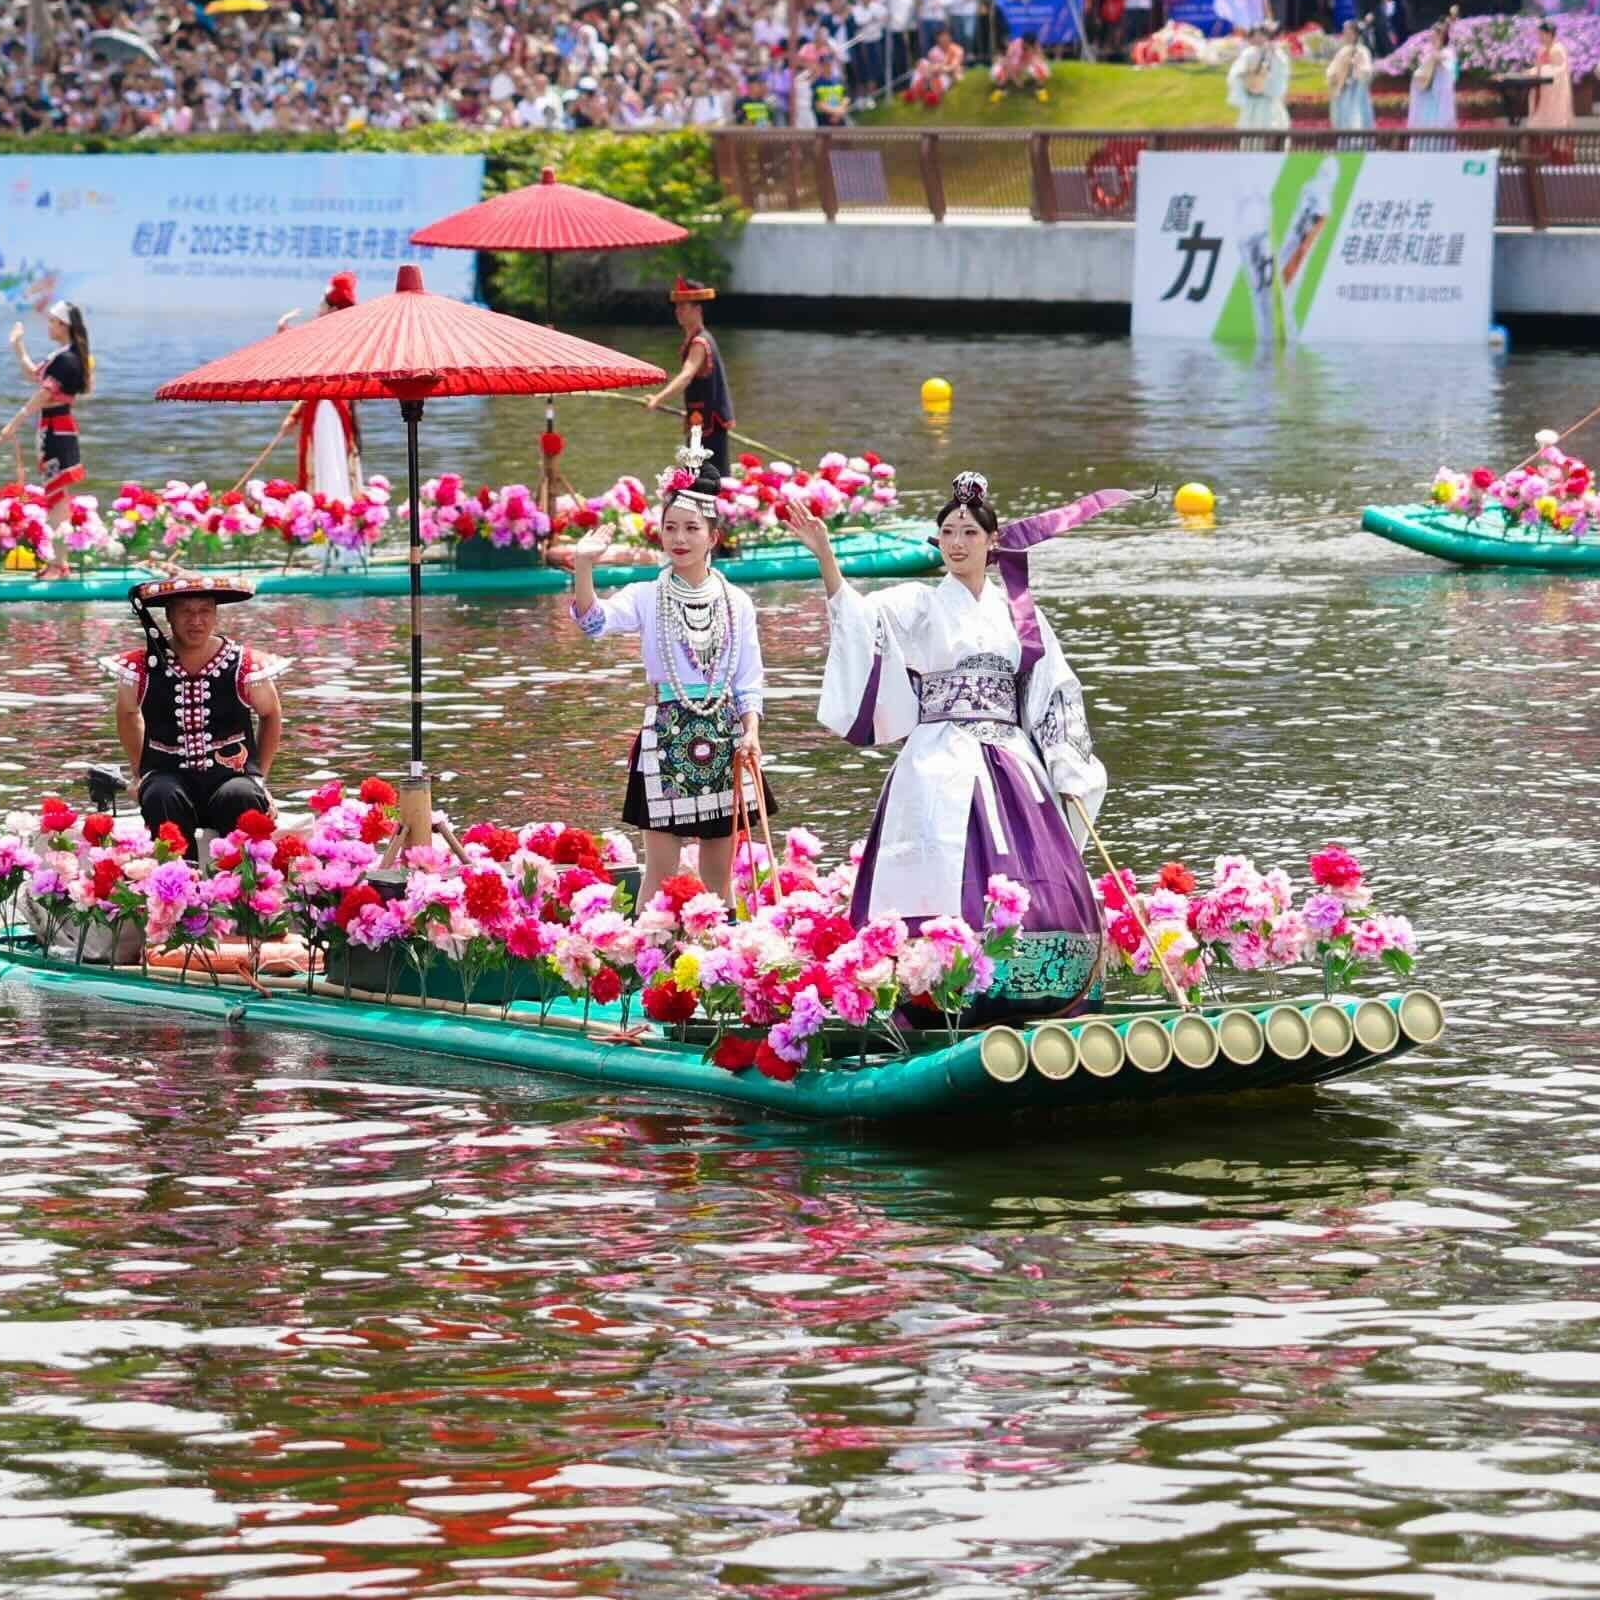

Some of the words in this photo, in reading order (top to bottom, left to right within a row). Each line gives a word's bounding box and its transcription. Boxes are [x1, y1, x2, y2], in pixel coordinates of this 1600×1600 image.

[1350, 199, 1434, 230] 快速补充
[1341, 232, 1464, 266] 电解质和能量
